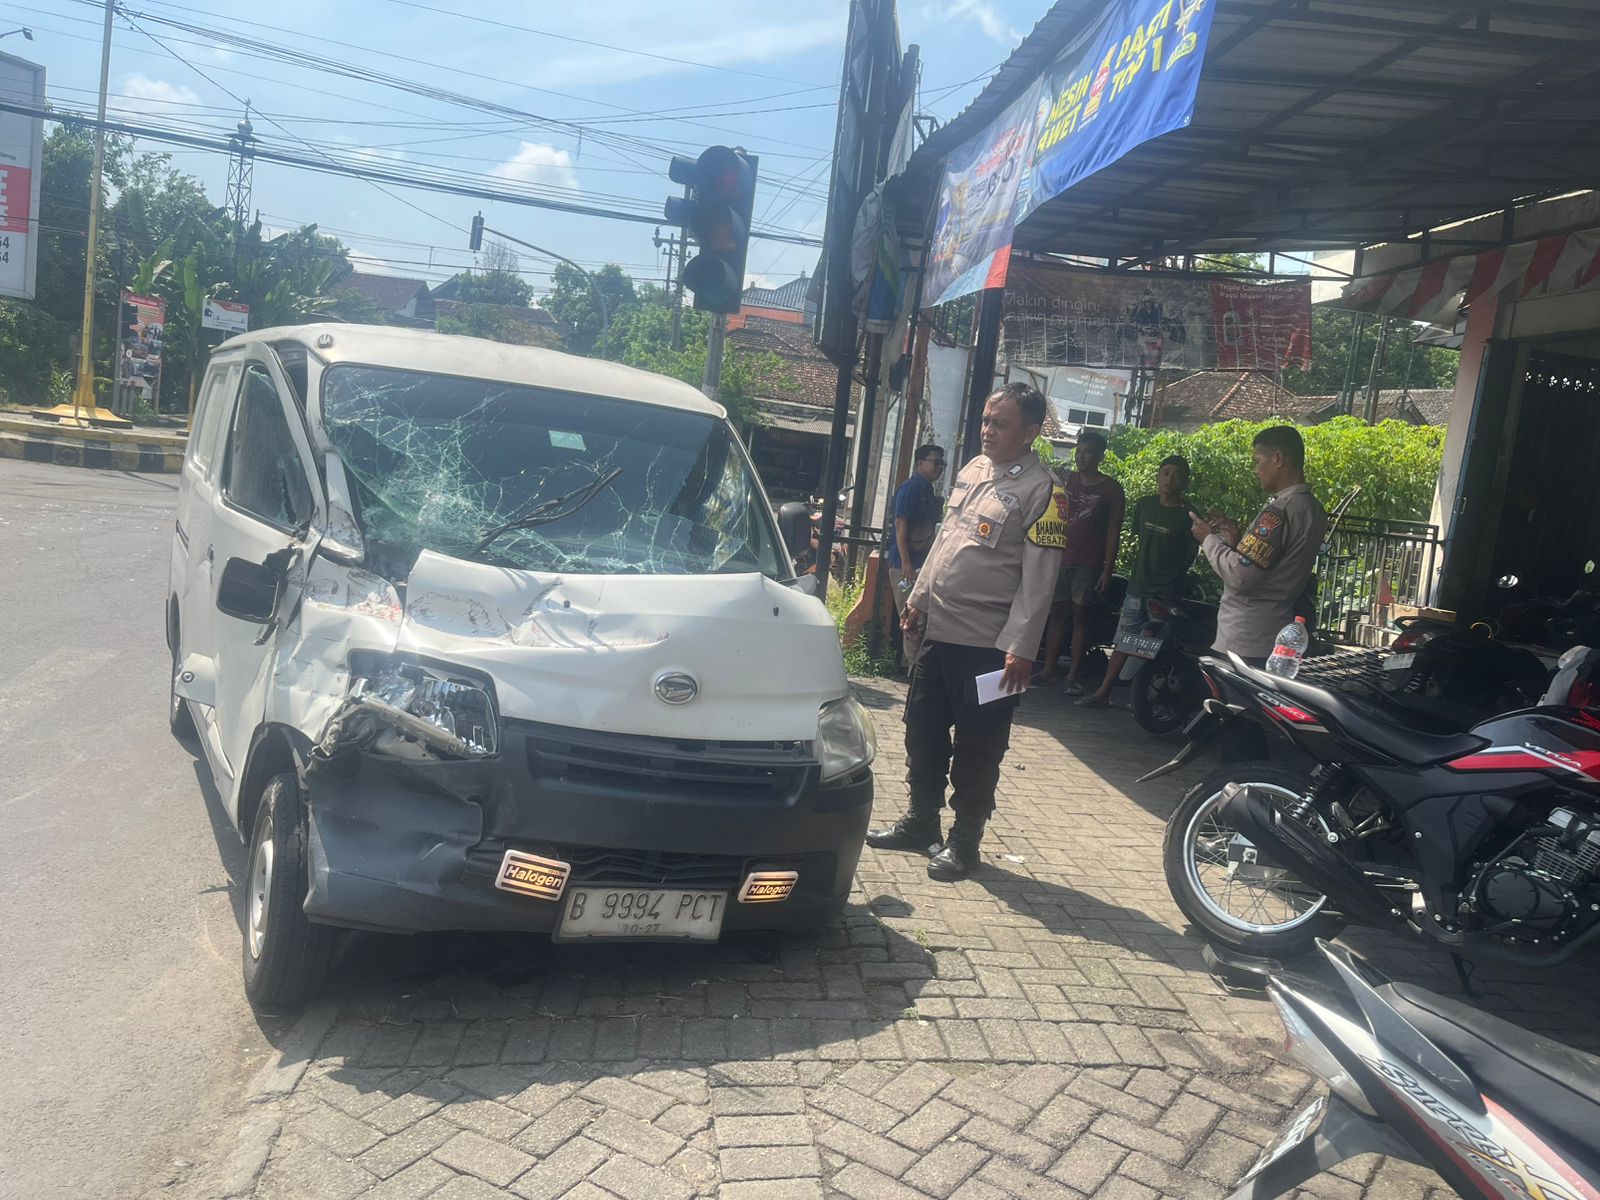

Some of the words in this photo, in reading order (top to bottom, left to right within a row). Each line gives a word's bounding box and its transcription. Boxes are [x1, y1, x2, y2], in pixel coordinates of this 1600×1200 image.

[1109, 48, 1147, 103] TOP
[1152, 35, 1164, 72] 1
[1045, 69, 1094, 128] MESIN
[1037, 102, 1083, 153] AWET
[989, 490, 1012, 506] POLRI
[505, 865, 564, 889] Halogen
[749, 883, 792, 897] Halogen
[568, 892, 587, 921] B
[601, 892, 666, 920] 9994
[675, 893, 722, 921] PCT
